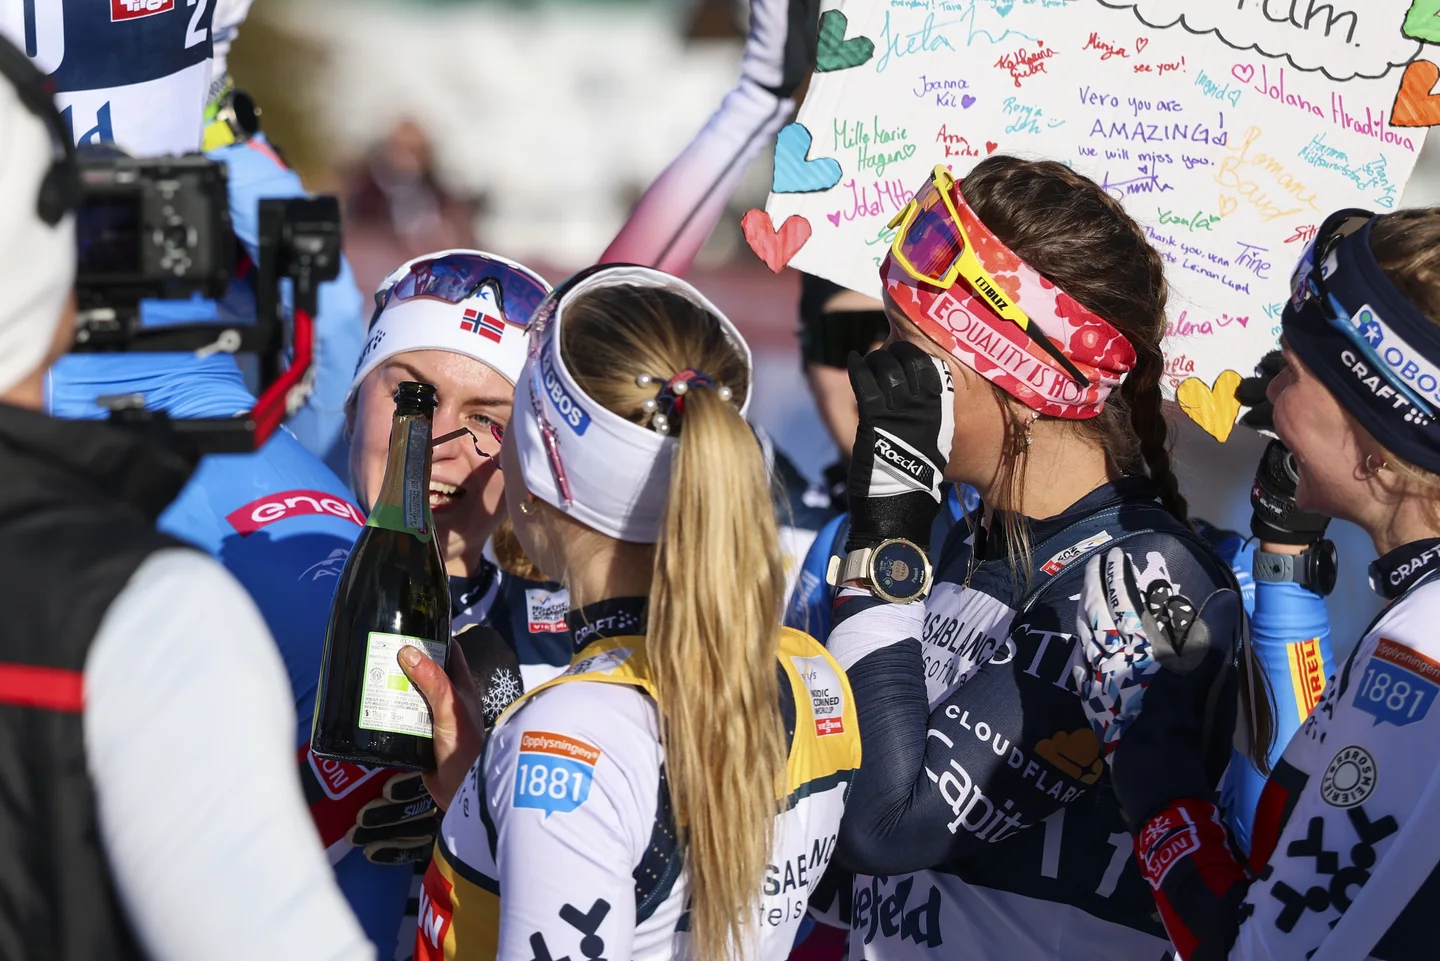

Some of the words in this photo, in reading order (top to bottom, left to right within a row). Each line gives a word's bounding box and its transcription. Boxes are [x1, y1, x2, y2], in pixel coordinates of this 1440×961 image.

[1079, 85, 1119, 107] Vero
[1128, 97, 1151, 117] you
[1156, 100, 1183, 112] are
[1105, 149, 1129, 160] will
[1138, 151, 1173, 163] miss
[986, 288, 1009, 311] BLIZ
[933, 295, 1031, 372] EQUALITY
[1026, 364, 1050, 387] IS
[1340, 349, 1410, 410] CRAFT
[545, 372, 583, 427] OBOS
[250, 494, 362, 525] enel
[1106, 560, 1120, 609] AUCLAIR
[574, 616, 616, 645] CRAFT
[1360, 668, 1426, 719] 1881
[519, 763, 584, 802] 1881
